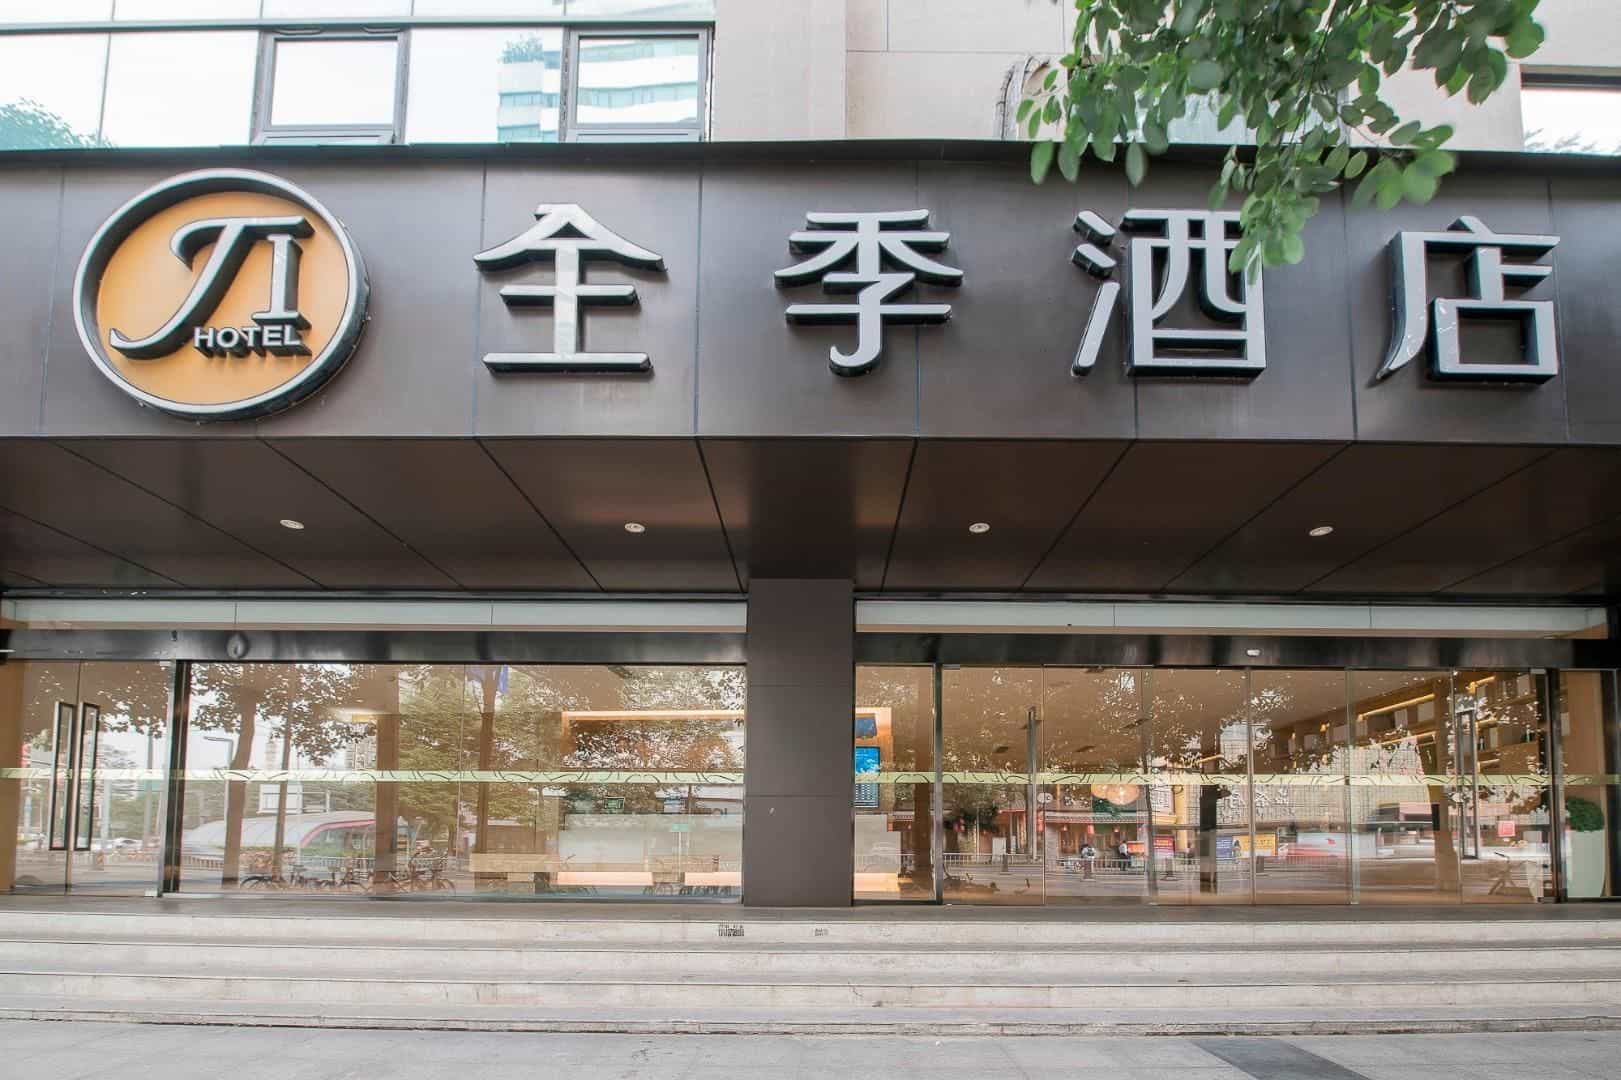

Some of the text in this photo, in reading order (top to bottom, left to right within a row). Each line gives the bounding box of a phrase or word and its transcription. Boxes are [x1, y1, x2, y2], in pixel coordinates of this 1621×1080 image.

[193, 324, 306, 353] HOTEL
[473, 203, 1561, 383] 全季酒店
